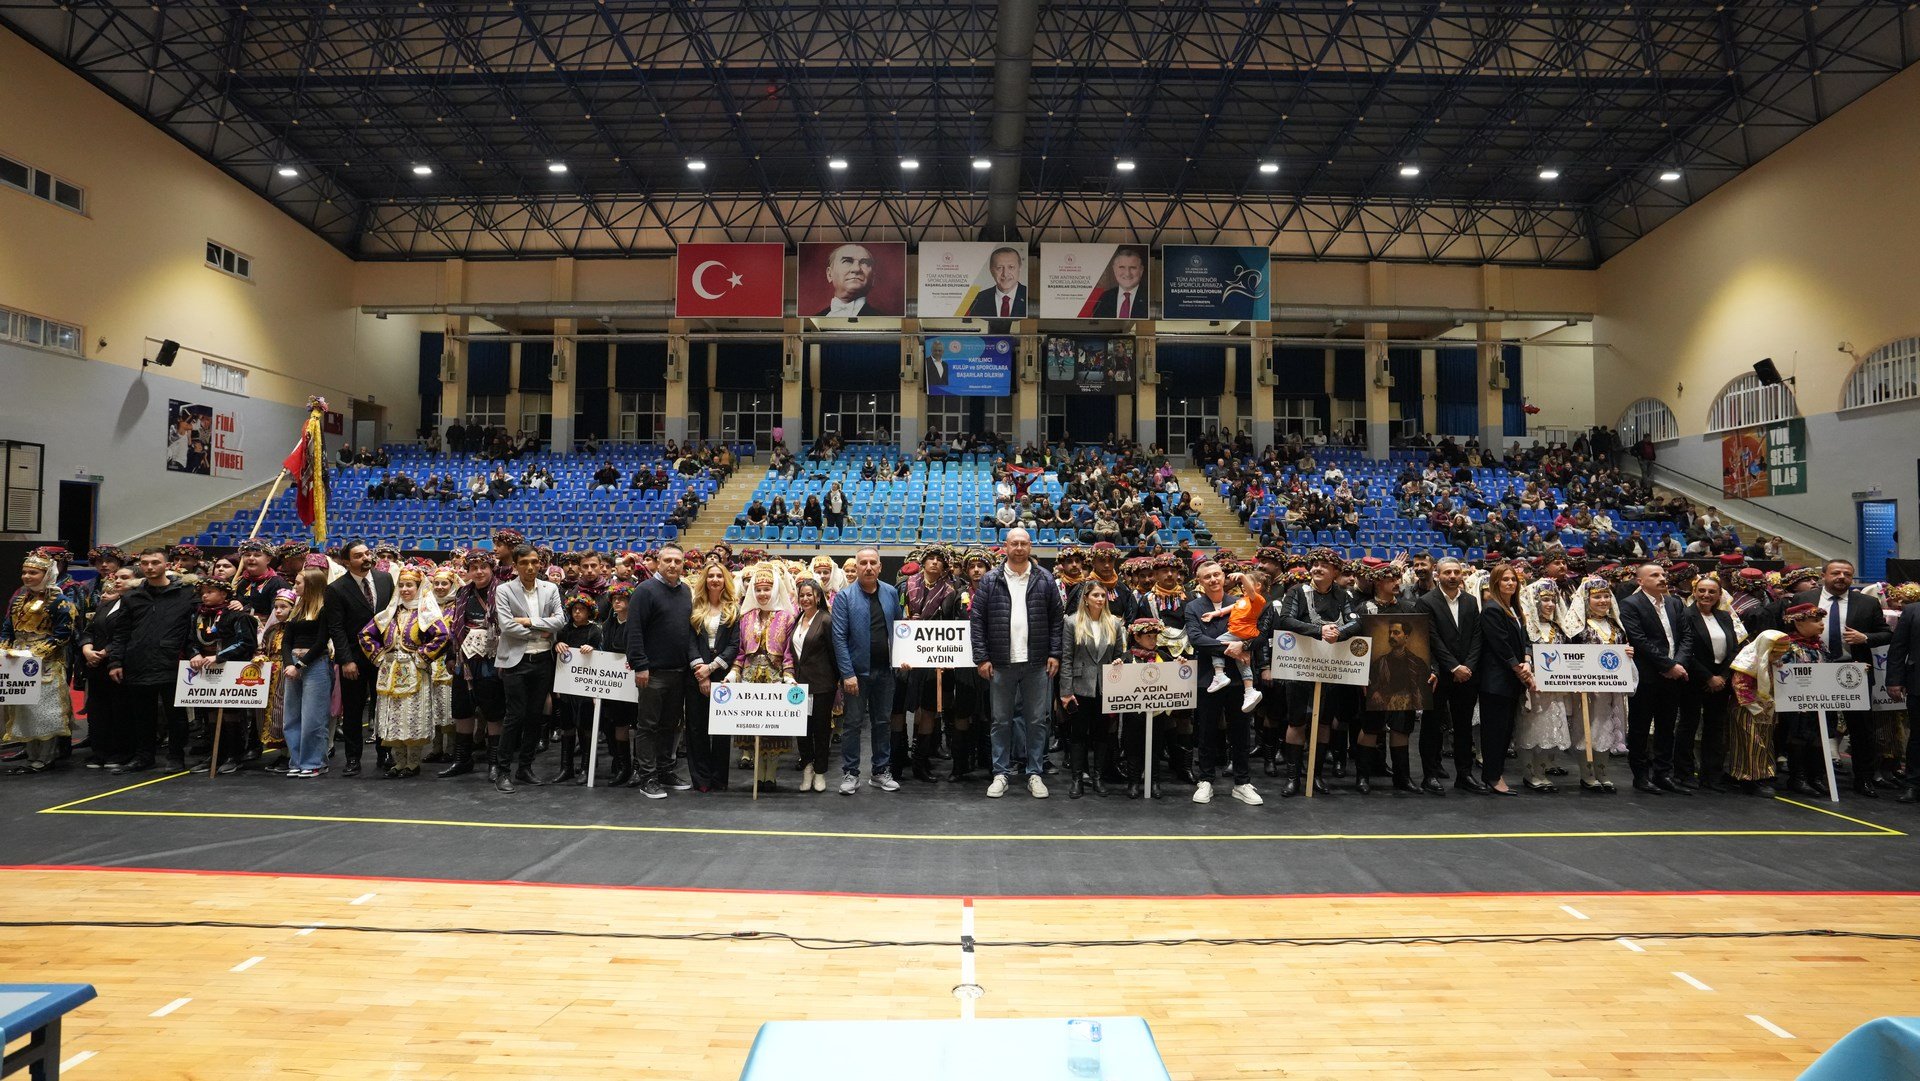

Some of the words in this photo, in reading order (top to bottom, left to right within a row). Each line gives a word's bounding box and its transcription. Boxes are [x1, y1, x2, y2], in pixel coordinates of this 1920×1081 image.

[215, 433, 225, 449] LE
[1771, 467, 1797, 486] ULAŞ
[914, 628, 965, 640] AYHOT
[917, 645, 934, 654] Spor
[571, 665, 597, 676] DERİN
[600, 670, 628, 680] SANAT
[1793, 667, 1812, 675] THOF
[595, 679, 622, 688] KULÜBÜ
[1134, 685, 1168, 693] AYDIN
[1143, 690, 1192, 701] AKADEMİ
[1146, 699, 1189, 708] KULÜBÜ
[766, 709, 801, 718] KULÜBÜ
